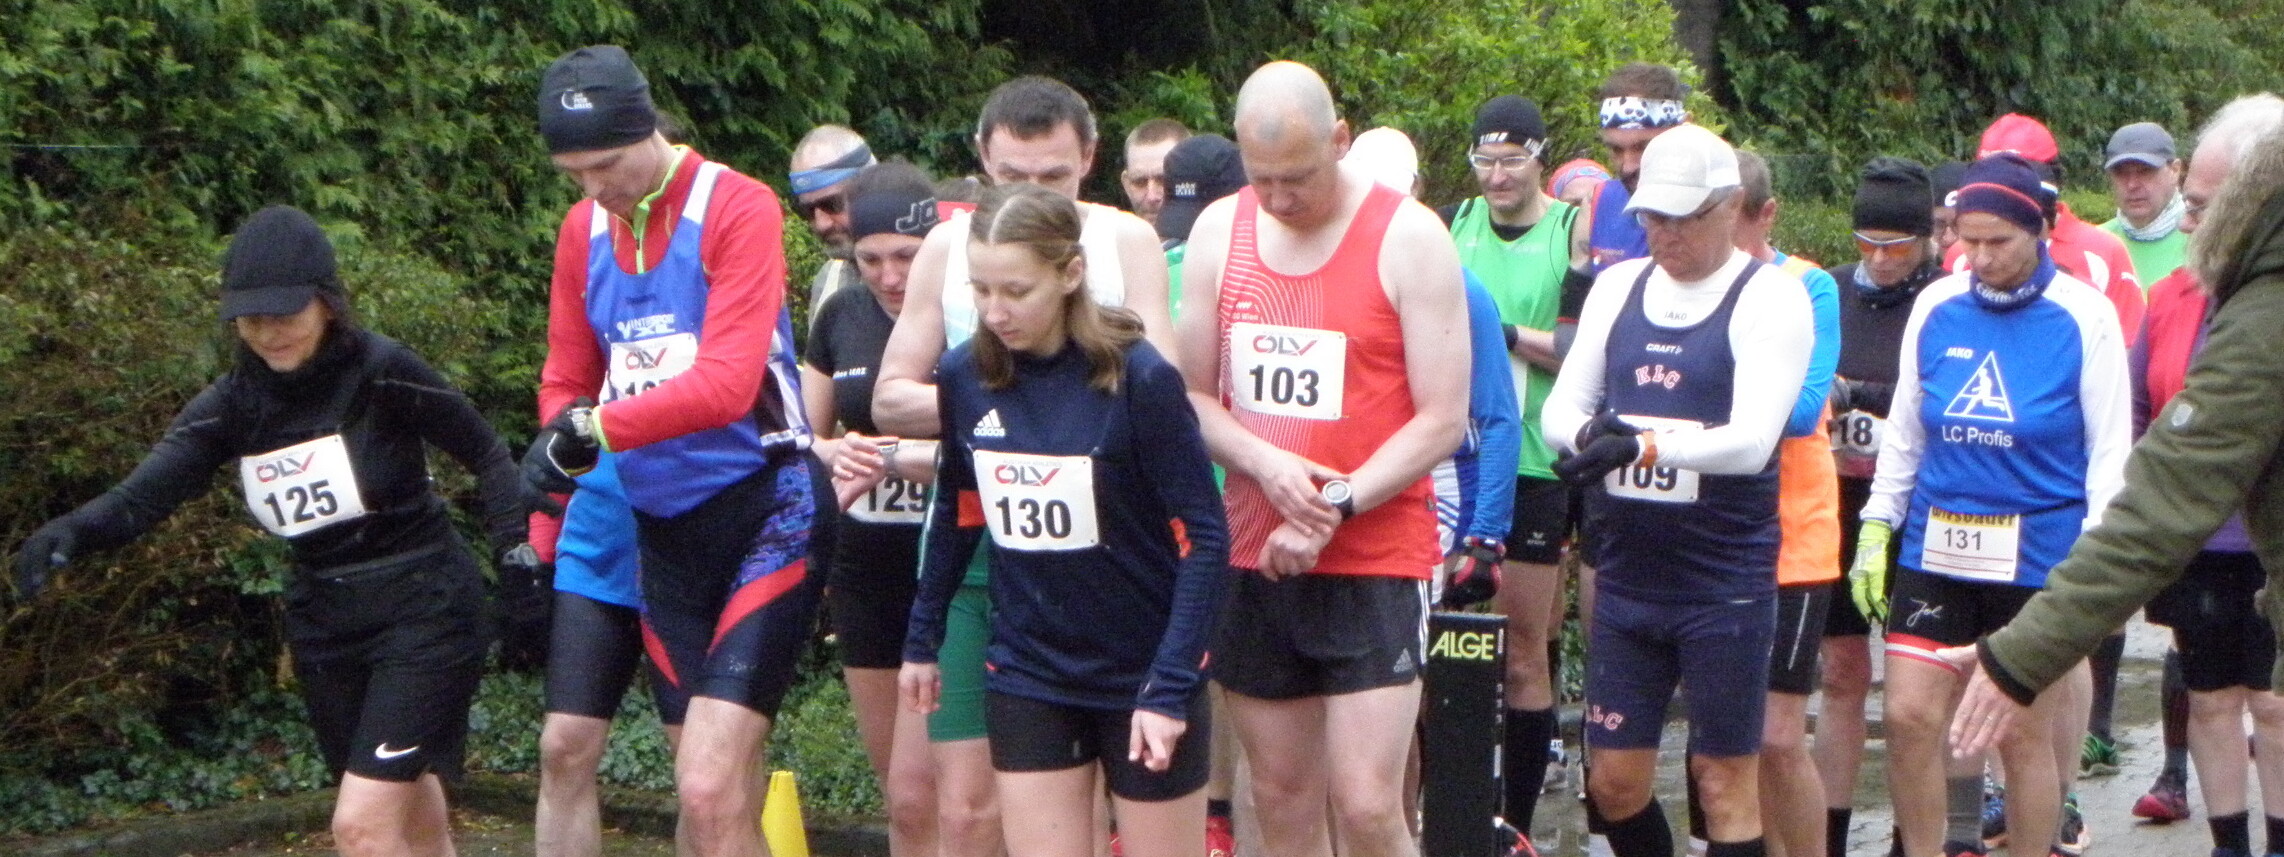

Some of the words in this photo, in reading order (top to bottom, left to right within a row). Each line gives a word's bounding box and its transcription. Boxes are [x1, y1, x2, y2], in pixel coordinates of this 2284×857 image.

[1645, 343, 1676, 353] CRAFT
[1946, 347, 1974, 360] JAKO
[1249, 364, 1320, 407] 103
[973, 427, 1006, 437] adidas
[1942, 425, 1963, 443] LC
[1967, 427, 2014, 447] Profis
[1618, 461, 1678, 491] 109
[263, 479, 338, 527] 125
[867, 475, 927, 512] 129
[995, 496, 1072, 539] 130
[1944, 527, 1982, 551] 131
[1429, 631, 1494, 661] ALGE
